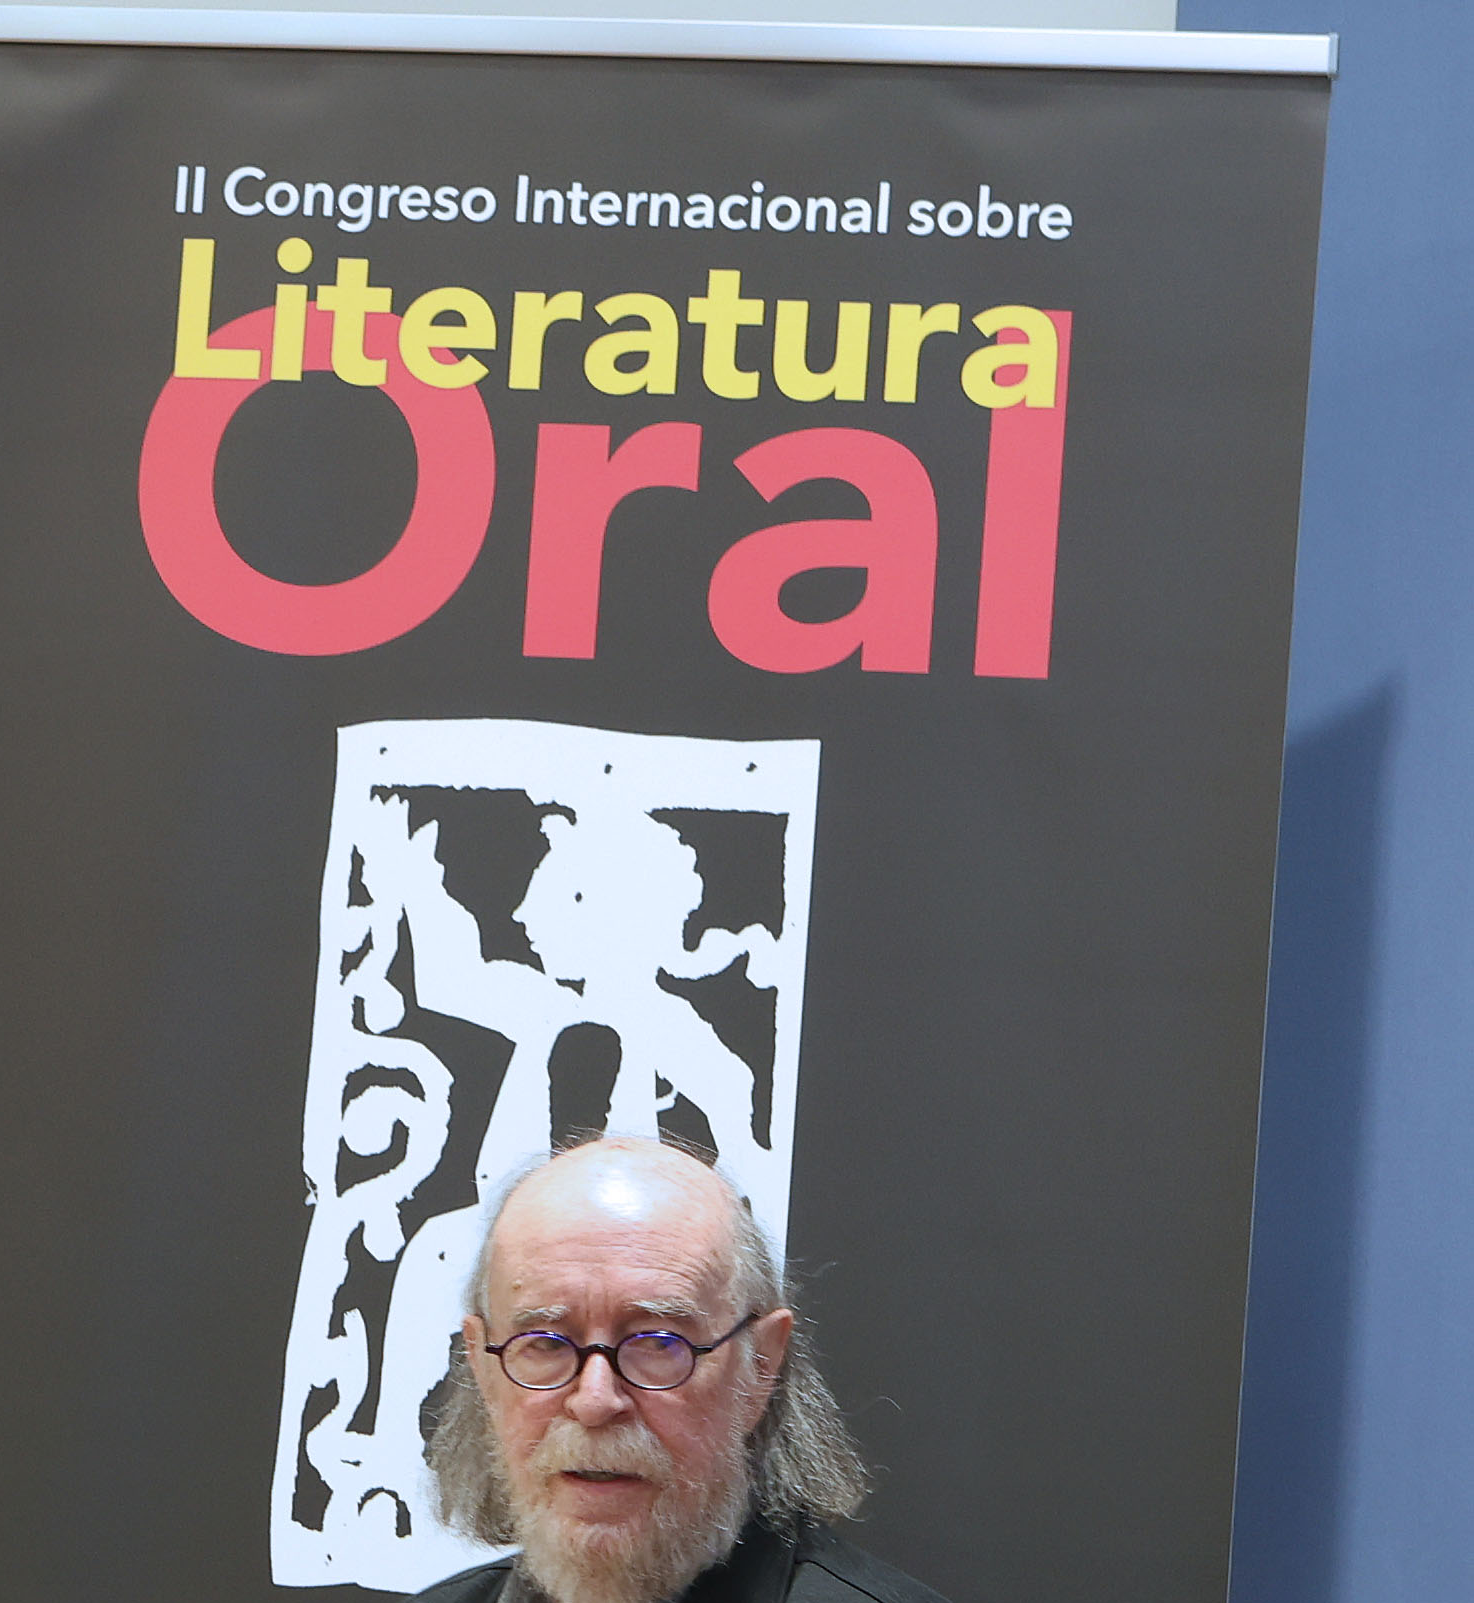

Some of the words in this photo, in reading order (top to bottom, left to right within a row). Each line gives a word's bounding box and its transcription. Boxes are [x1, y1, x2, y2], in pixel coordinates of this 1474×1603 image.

[173, 166, 206, 214] II
[223, 166, 497, 232] Congreso
[515, 174, 892, 236] Internacional
[907, 186, 1074, 240] sobre
[174, 236, 1059, 409] Literatura
[138, 301, 1073, 681] Oral
